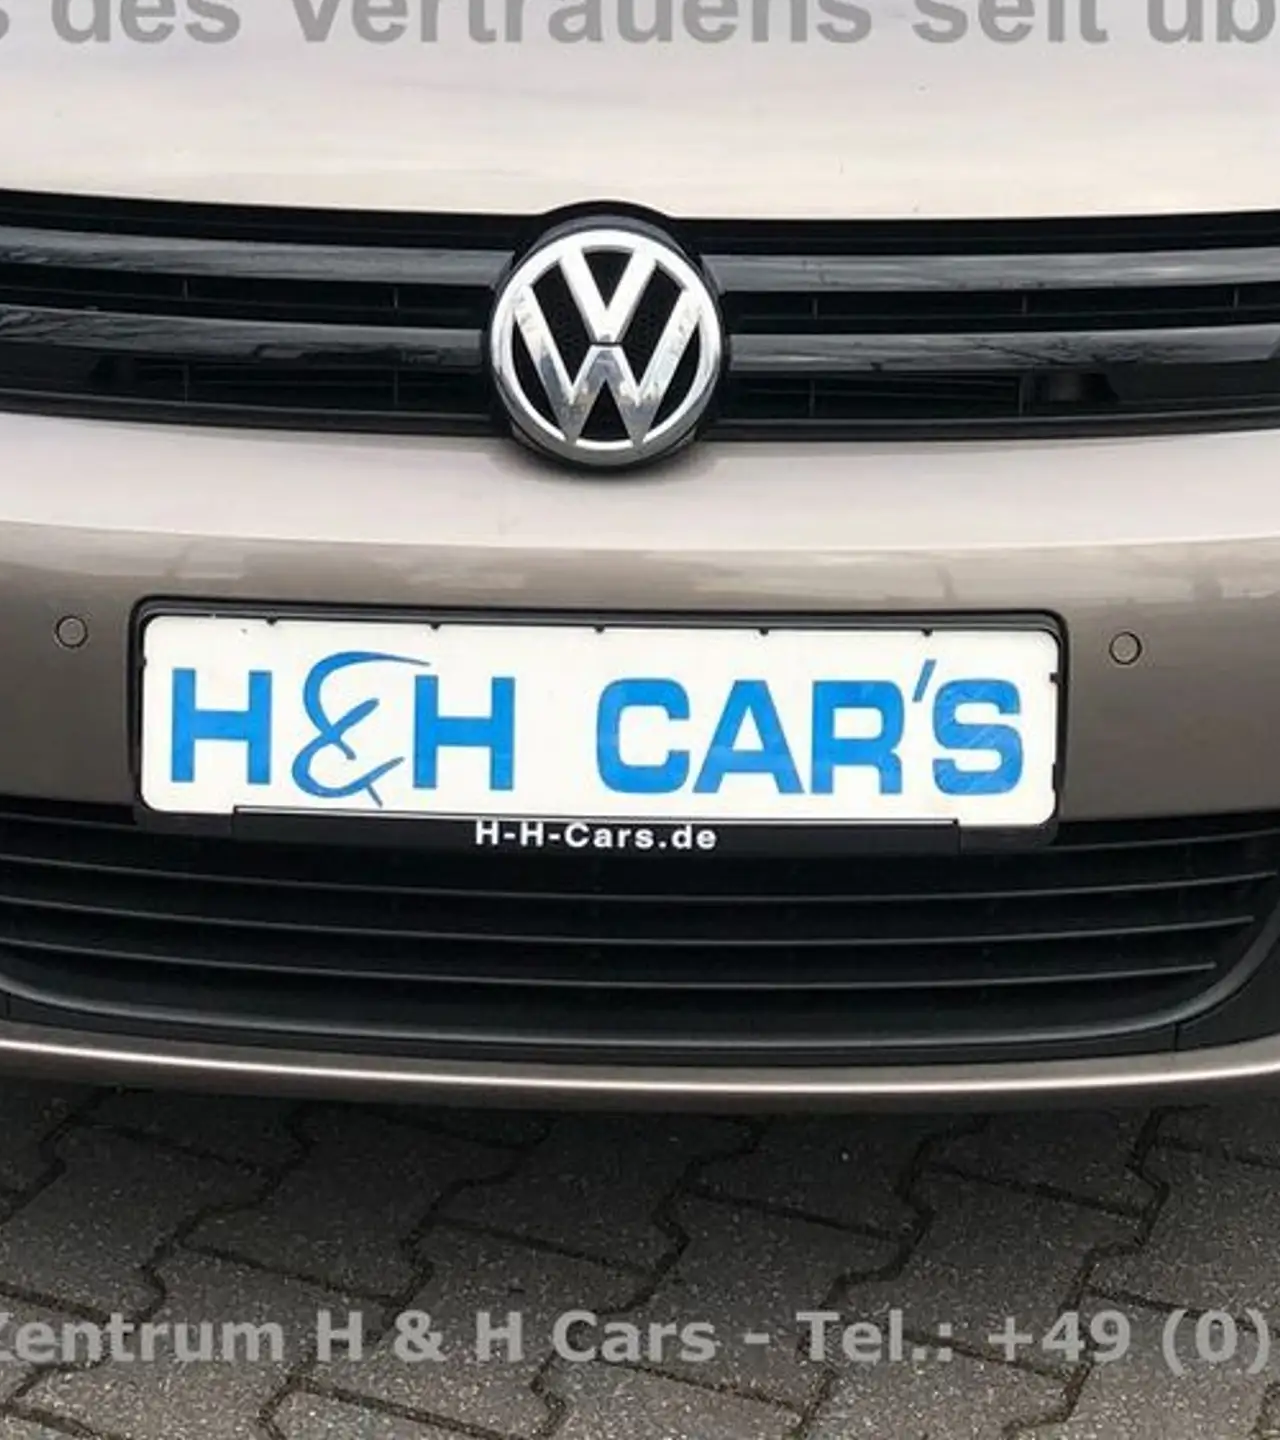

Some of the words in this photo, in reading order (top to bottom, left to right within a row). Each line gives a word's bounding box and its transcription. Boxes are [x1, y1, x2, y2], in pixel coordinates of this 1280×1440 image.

[170, 650, 517, 807] H&H
[595, 659, 1025, 797] CAR'S
[475, 820, 718, 850] H-H-Cars.de
